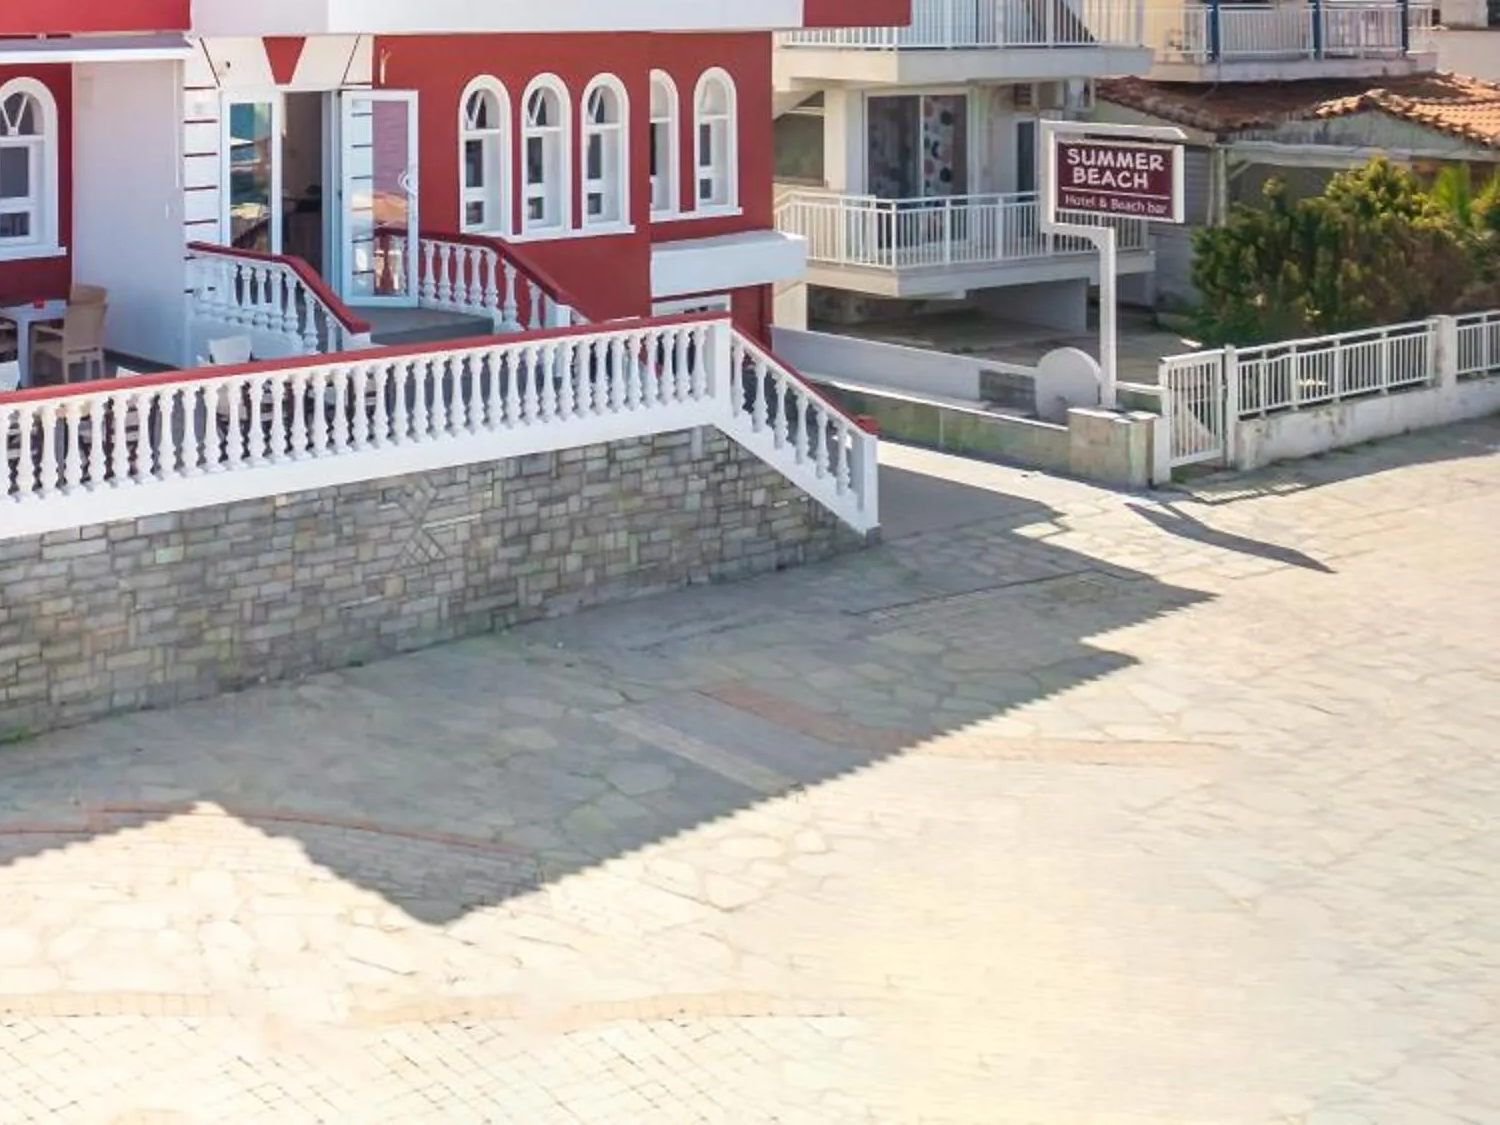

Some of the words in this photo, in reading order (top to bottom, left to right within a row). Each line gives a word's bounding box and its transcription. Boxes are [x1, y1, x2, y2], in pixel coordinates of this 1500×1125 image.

[1067, 148, 1164, 171] SUMMER
[1073, 167, 1148, 189] BEACH
[1065, 194, 1094, 207] Hotel
[1100, 197, 1107, 208] &
[1111, 198, 1145, 213] Beach
[1147, 201, 1167, 214] bar
